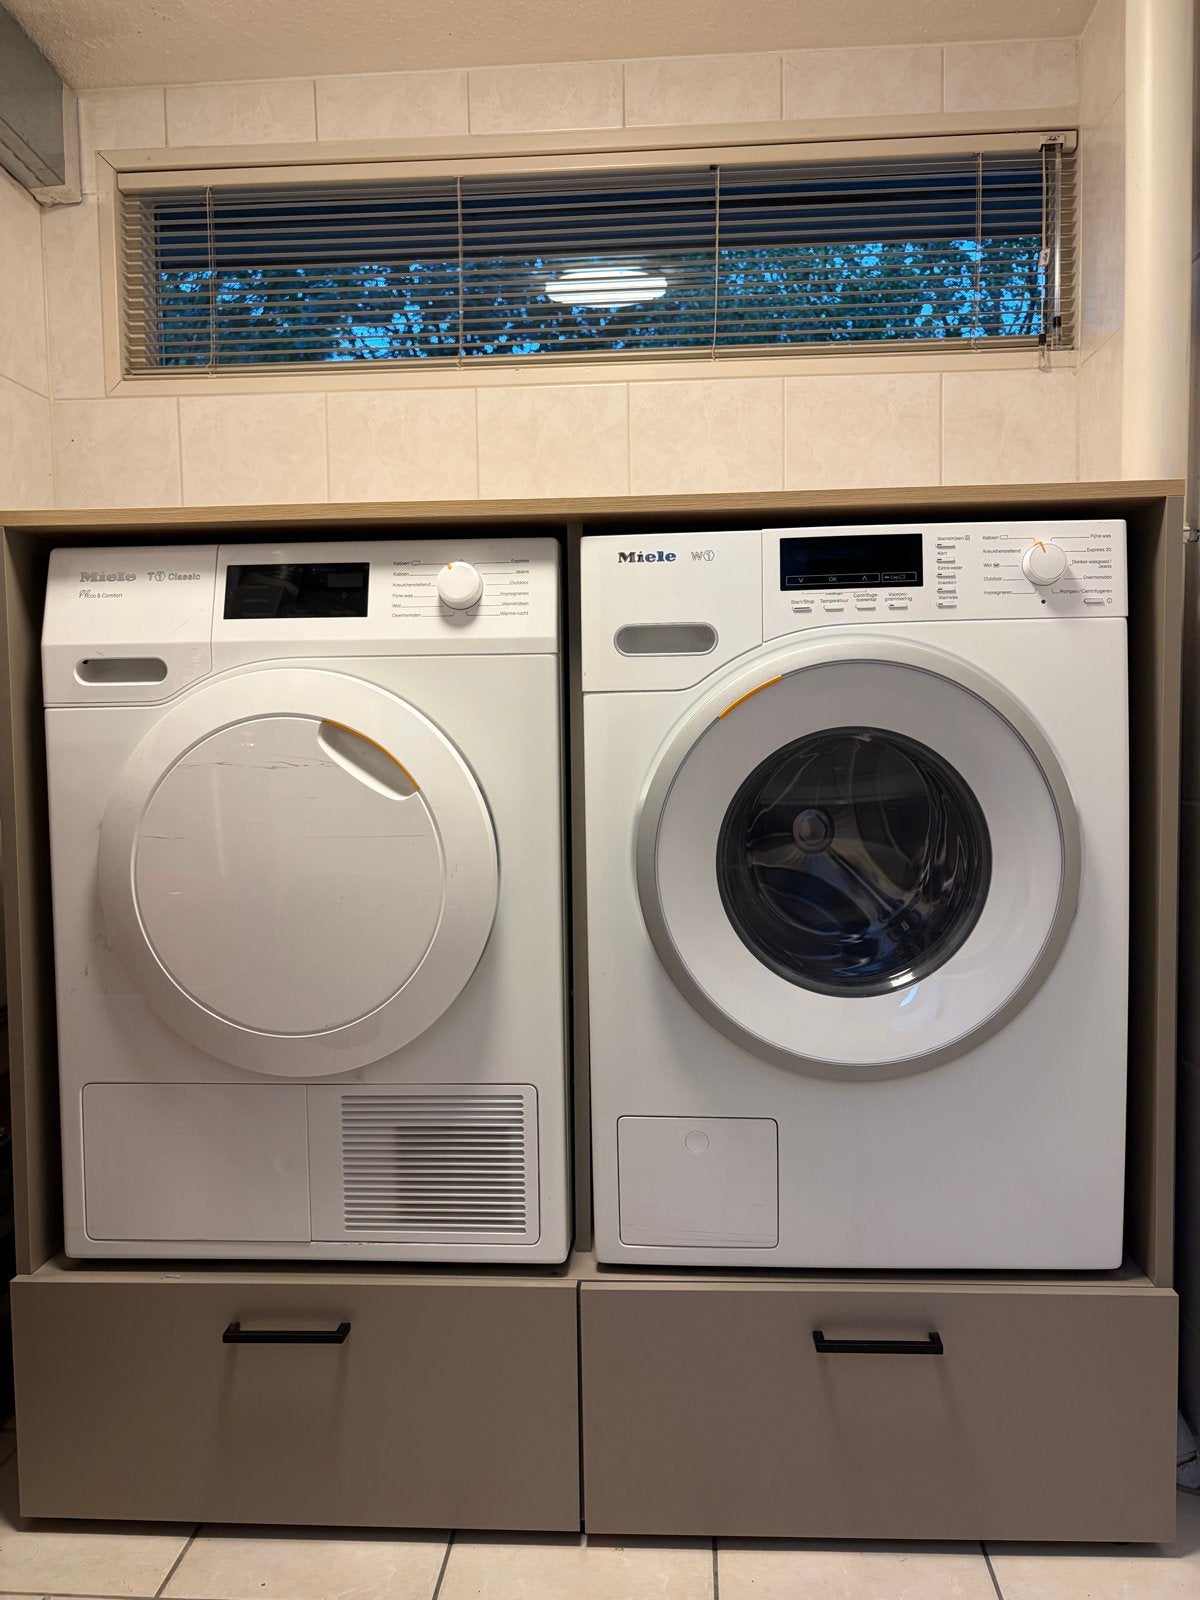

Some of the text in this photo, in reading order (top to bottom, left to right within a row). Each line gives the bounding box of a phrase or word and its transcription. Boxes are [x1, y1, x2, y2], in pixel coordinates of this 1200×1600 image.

[617, 551, 677, 563] Miele
[80, 571, 137, 583] Miele
[168, 573, 201, 581] Classic
